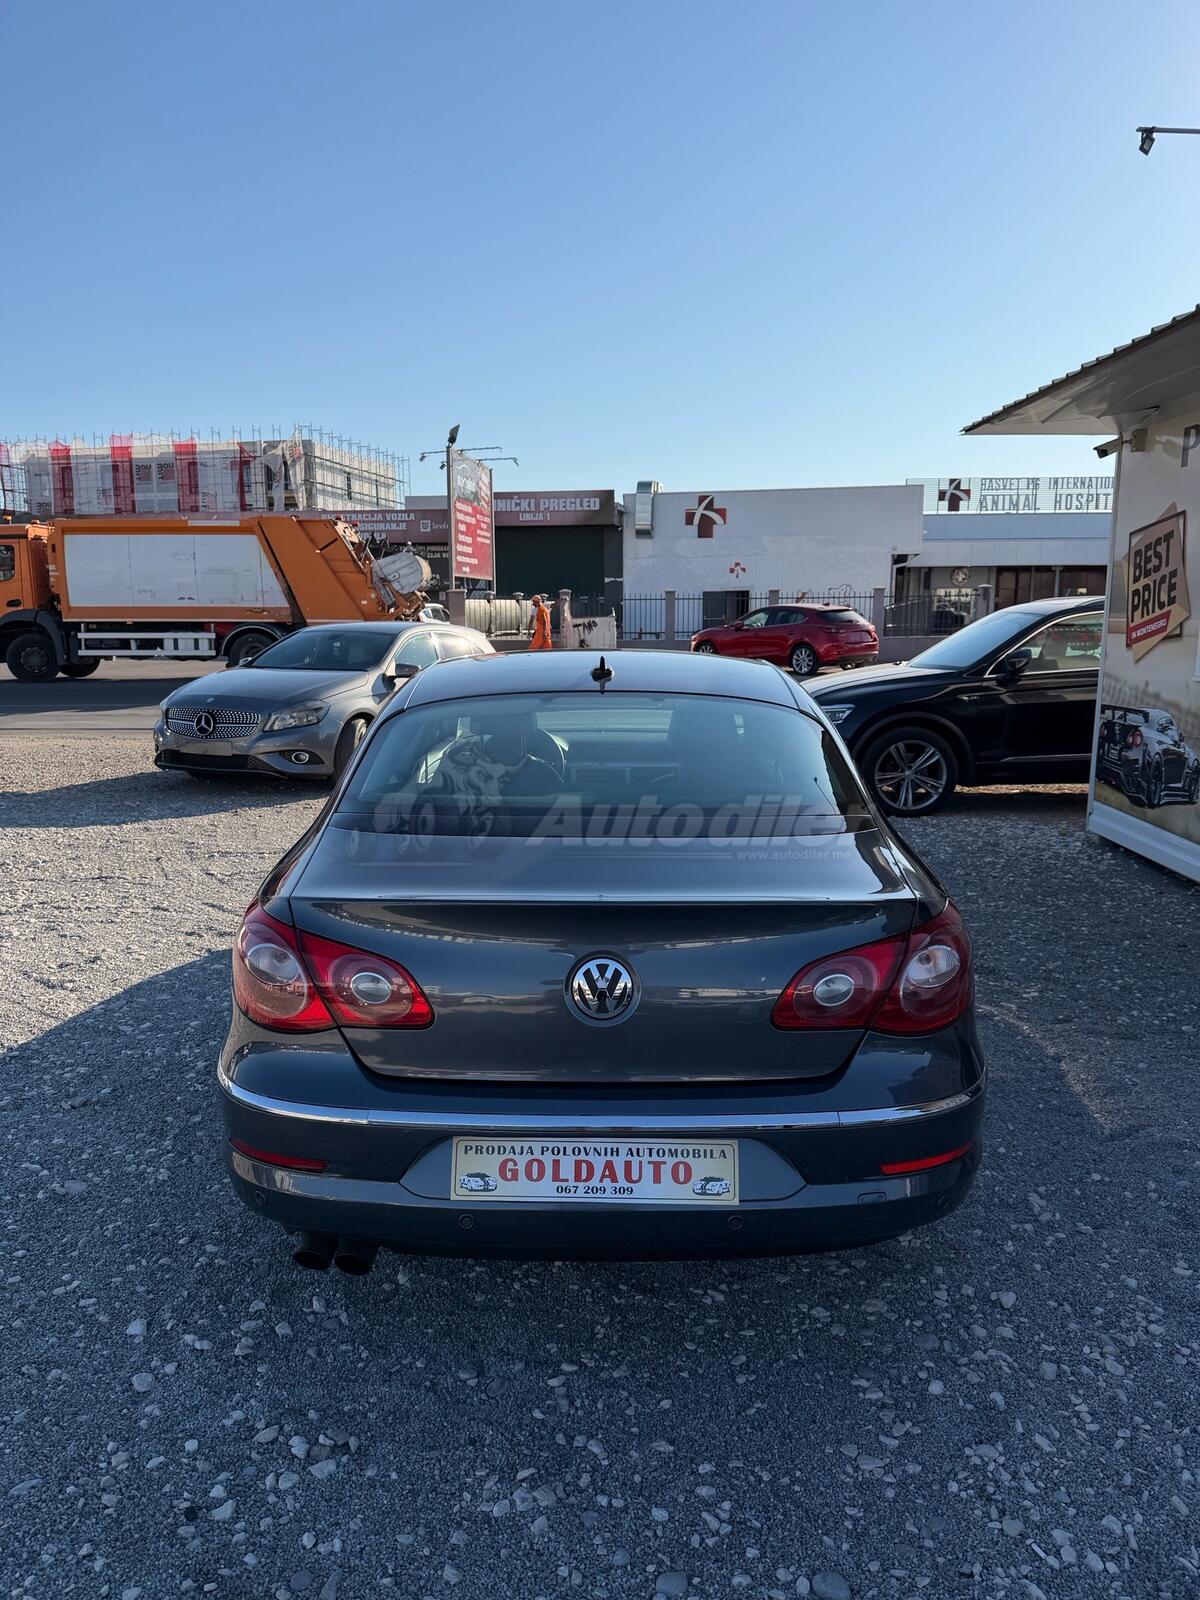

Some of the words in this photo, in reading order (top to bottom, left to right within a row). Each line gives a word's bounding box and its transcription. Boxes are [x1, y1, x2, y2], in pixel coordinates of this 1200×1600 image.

[541, 498, 600, 511] PREGLED
[980, 495, 1040, 511] ANIMAL
[385, 512, 415, 520] VOZILA
[358, 522, 407, 530] SIGURANJE
[1133, 530, 1174, 584] BEST
[1131, 568, 1178, 623] PRICE
[463, 1144, 535, 1156] PRODAJA
[540, 1145, 620, 1157] POLOVNIH
[625, 1147, 727, 1160] AUTOMOBILA
[498, 1157, 693, 1185] GOLDAUTO
[556, 1184, 579, 1194] 067
[583, 1186, 606, 1195] 209
[610, 1186, 634, 1195] 309
